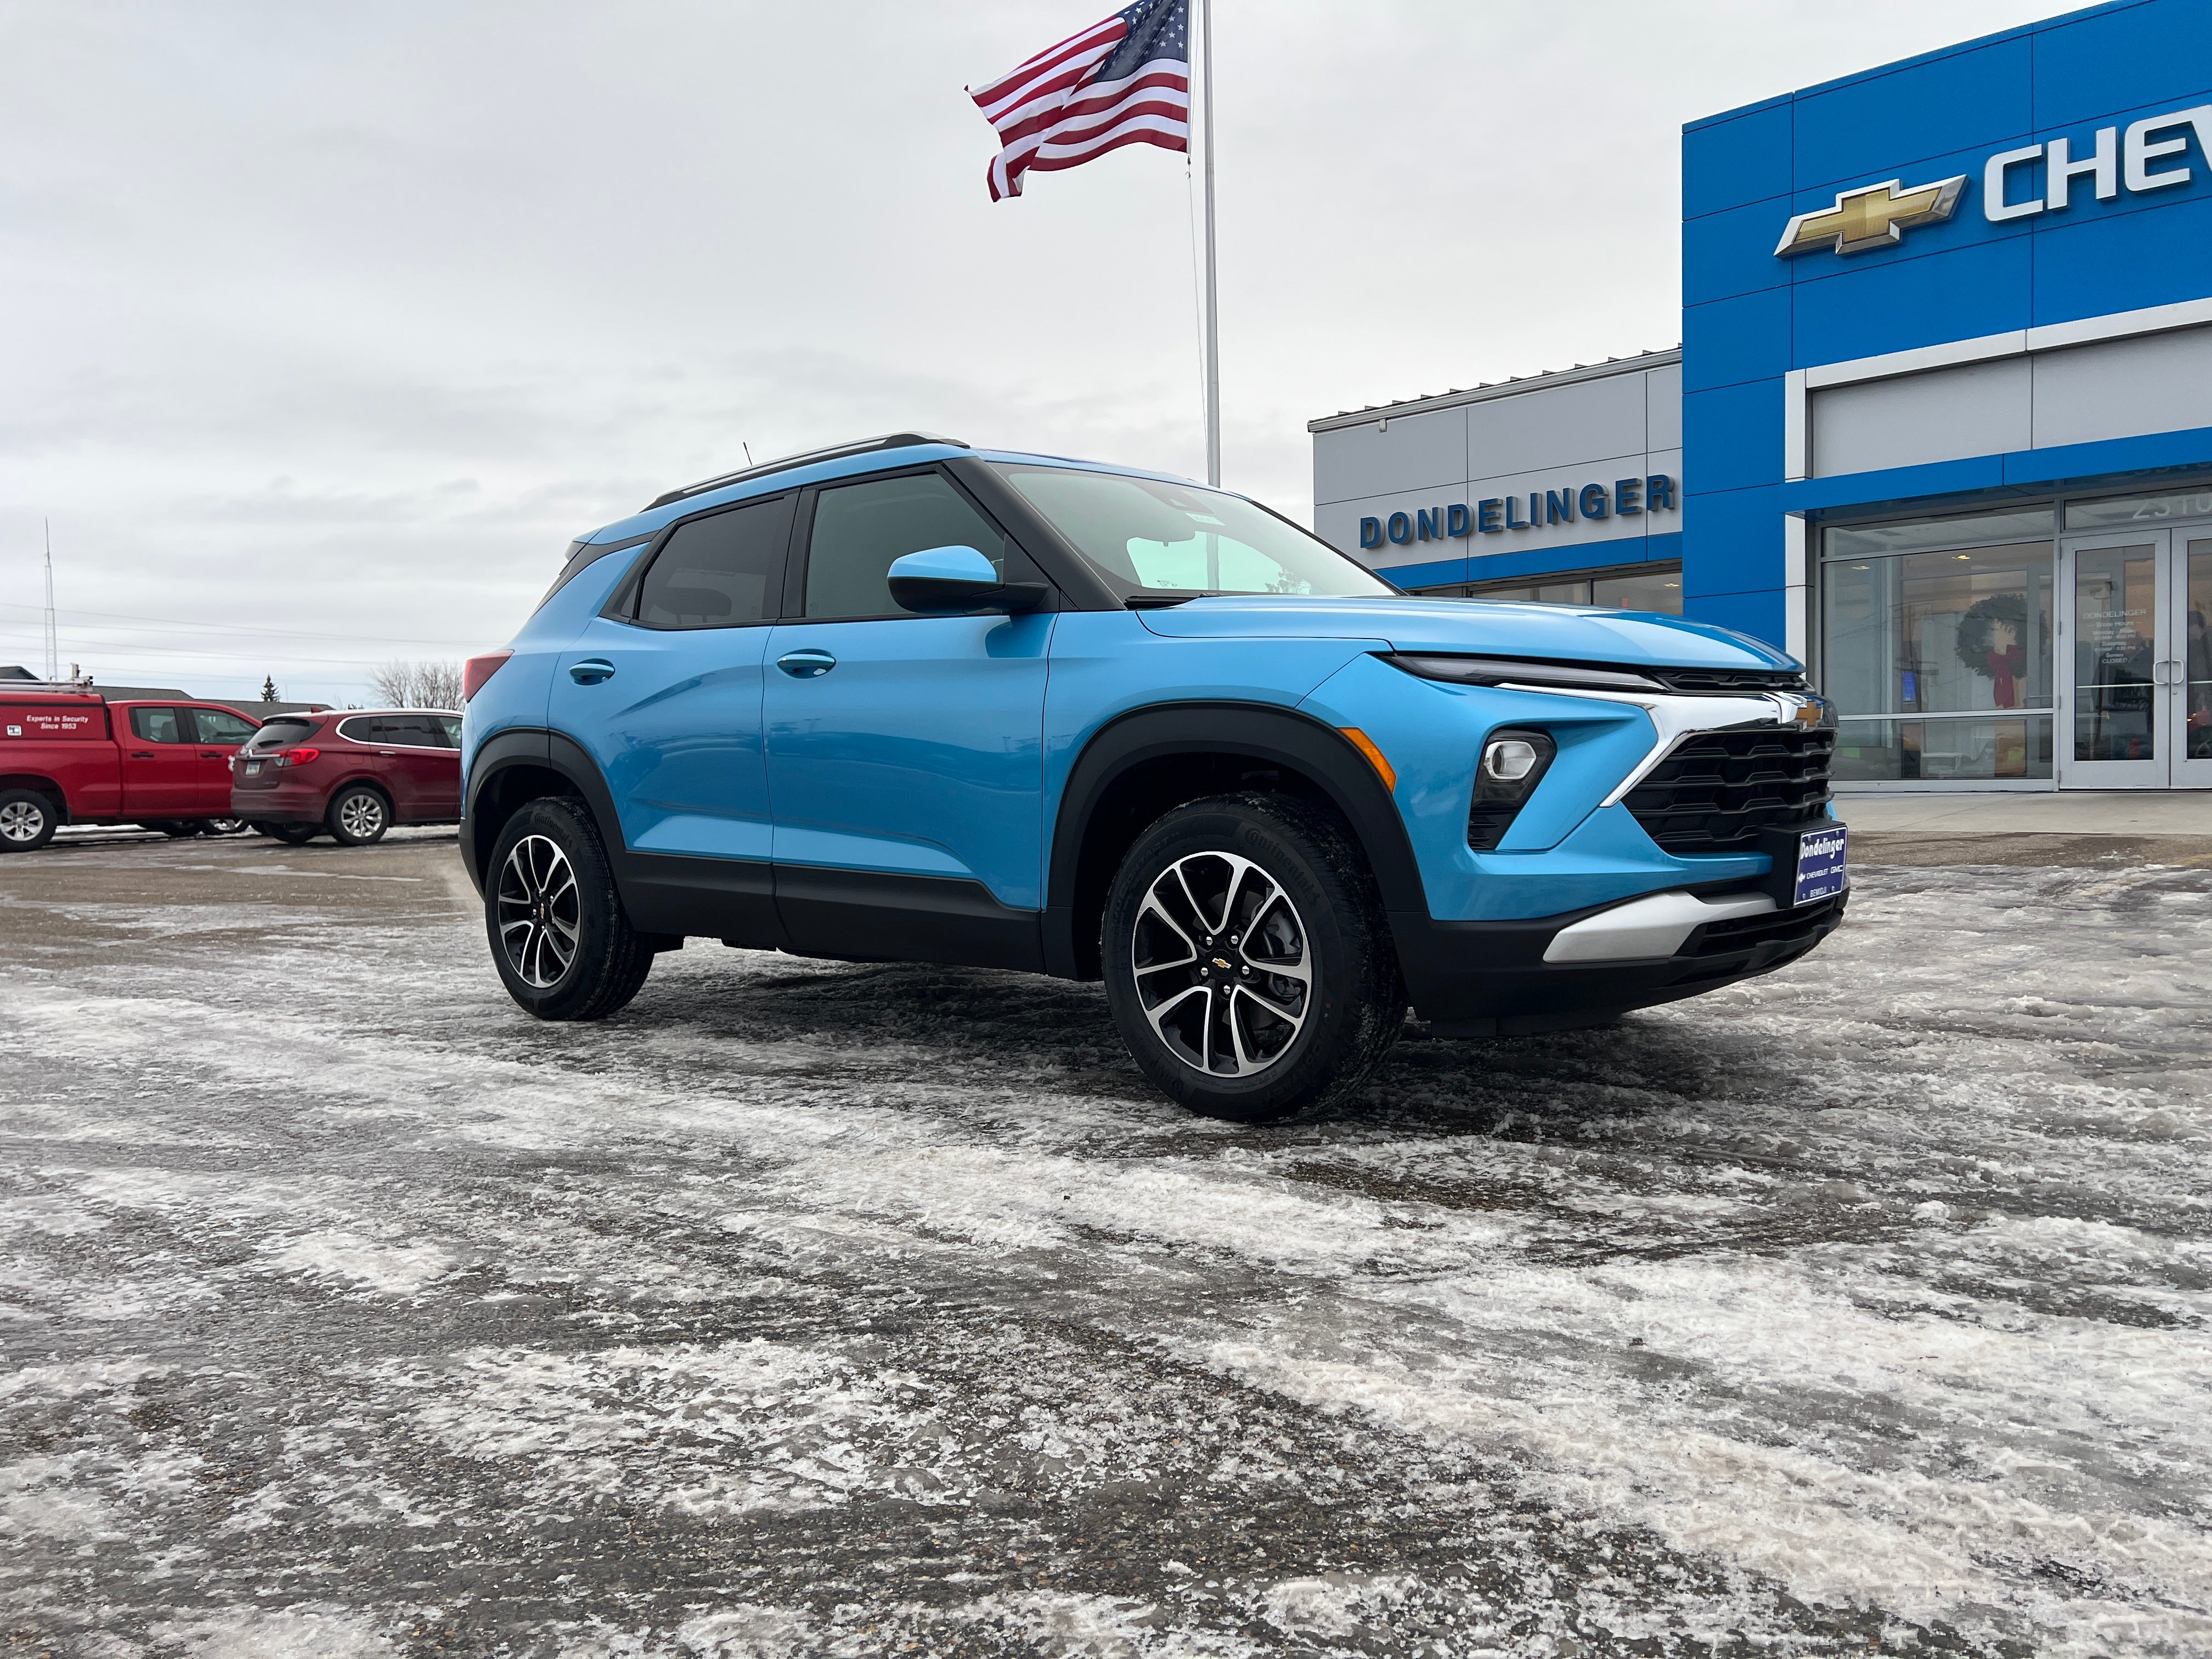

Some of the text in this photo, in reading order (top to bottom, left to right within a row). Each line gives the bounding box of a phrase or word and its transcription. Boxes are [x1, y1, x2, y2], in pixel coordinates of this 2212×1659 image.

[1984, 104, 2212, 222] CHE
[1360, 473, 1675, 549] DONDELINGER
[2084, 609, 2146, 619] DONDELINGER
[27, 714, 52, 723] Experts
[62, 715, 88, 724] Security
[534, 812, 568, 841] Continental
[1244, 827, 1316, 895] Continental
[1800, 837, 1844, 860] Dondelinger
[1807, 865, 1843, 879] CHEVROLET GMC
